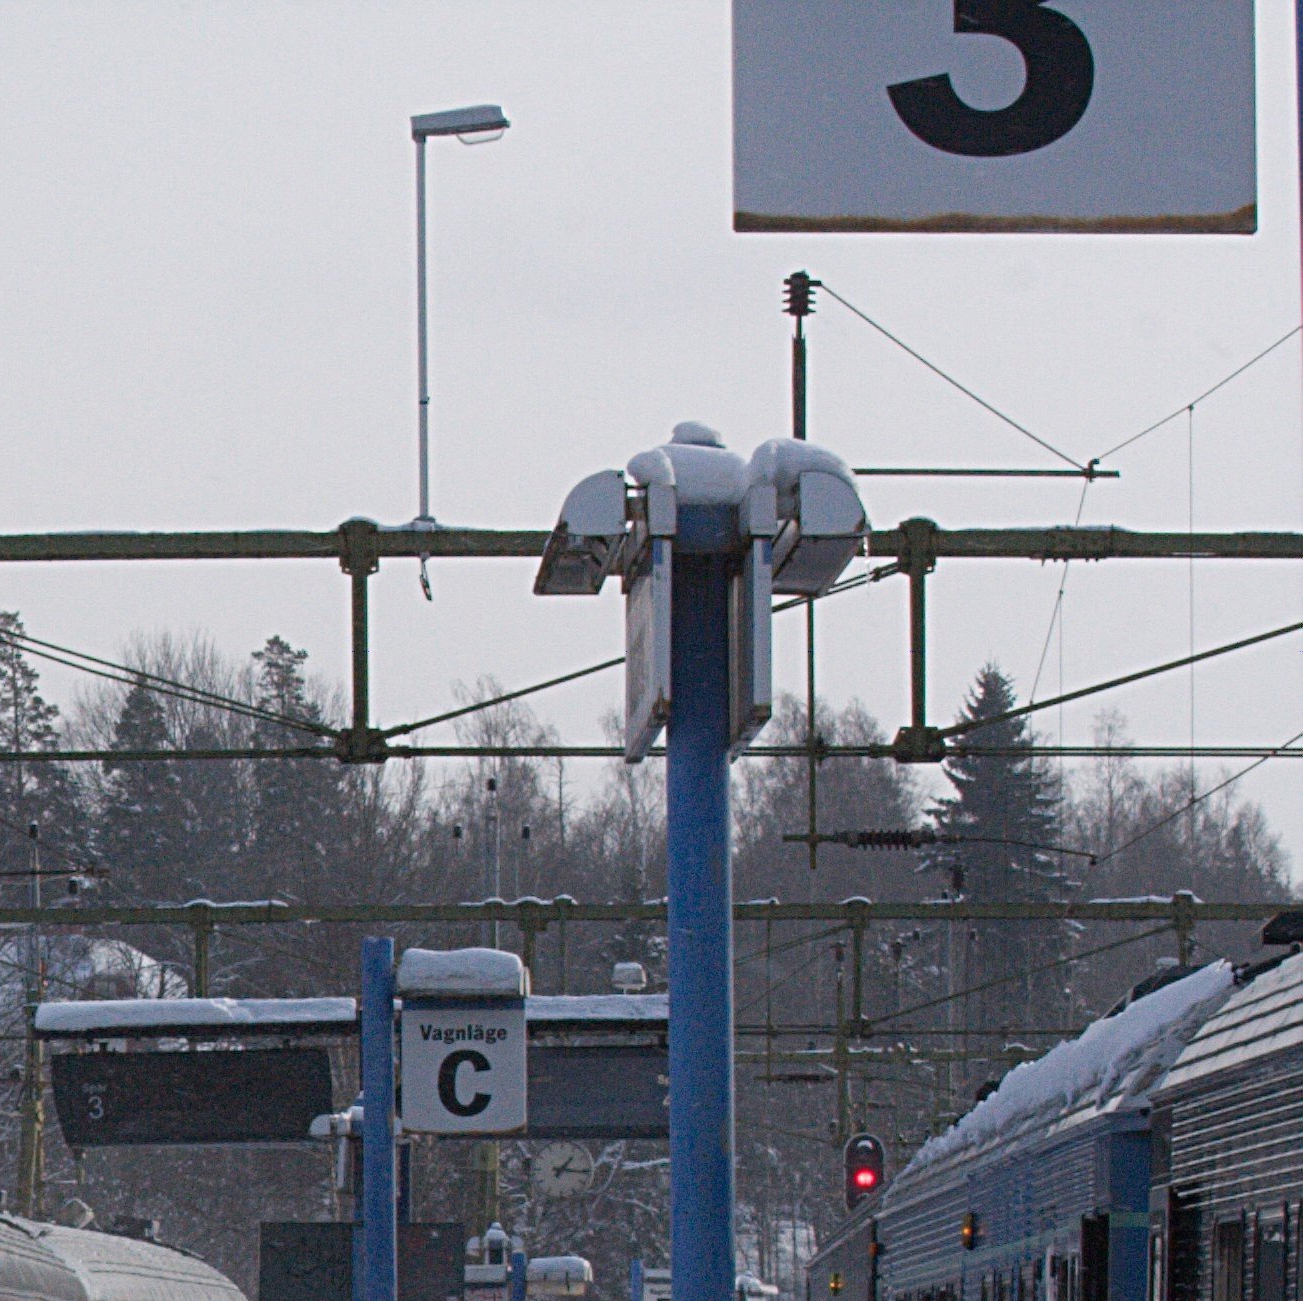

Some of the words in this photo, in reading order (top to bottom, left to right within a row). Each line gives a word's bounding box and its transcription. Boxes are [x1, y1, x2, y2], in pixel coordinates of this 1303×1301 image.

[419, 1023, 508, 1045] Vagnläge
[437, 1049, 492, 1117] C
[87, 1095, 104, 1119] 3
